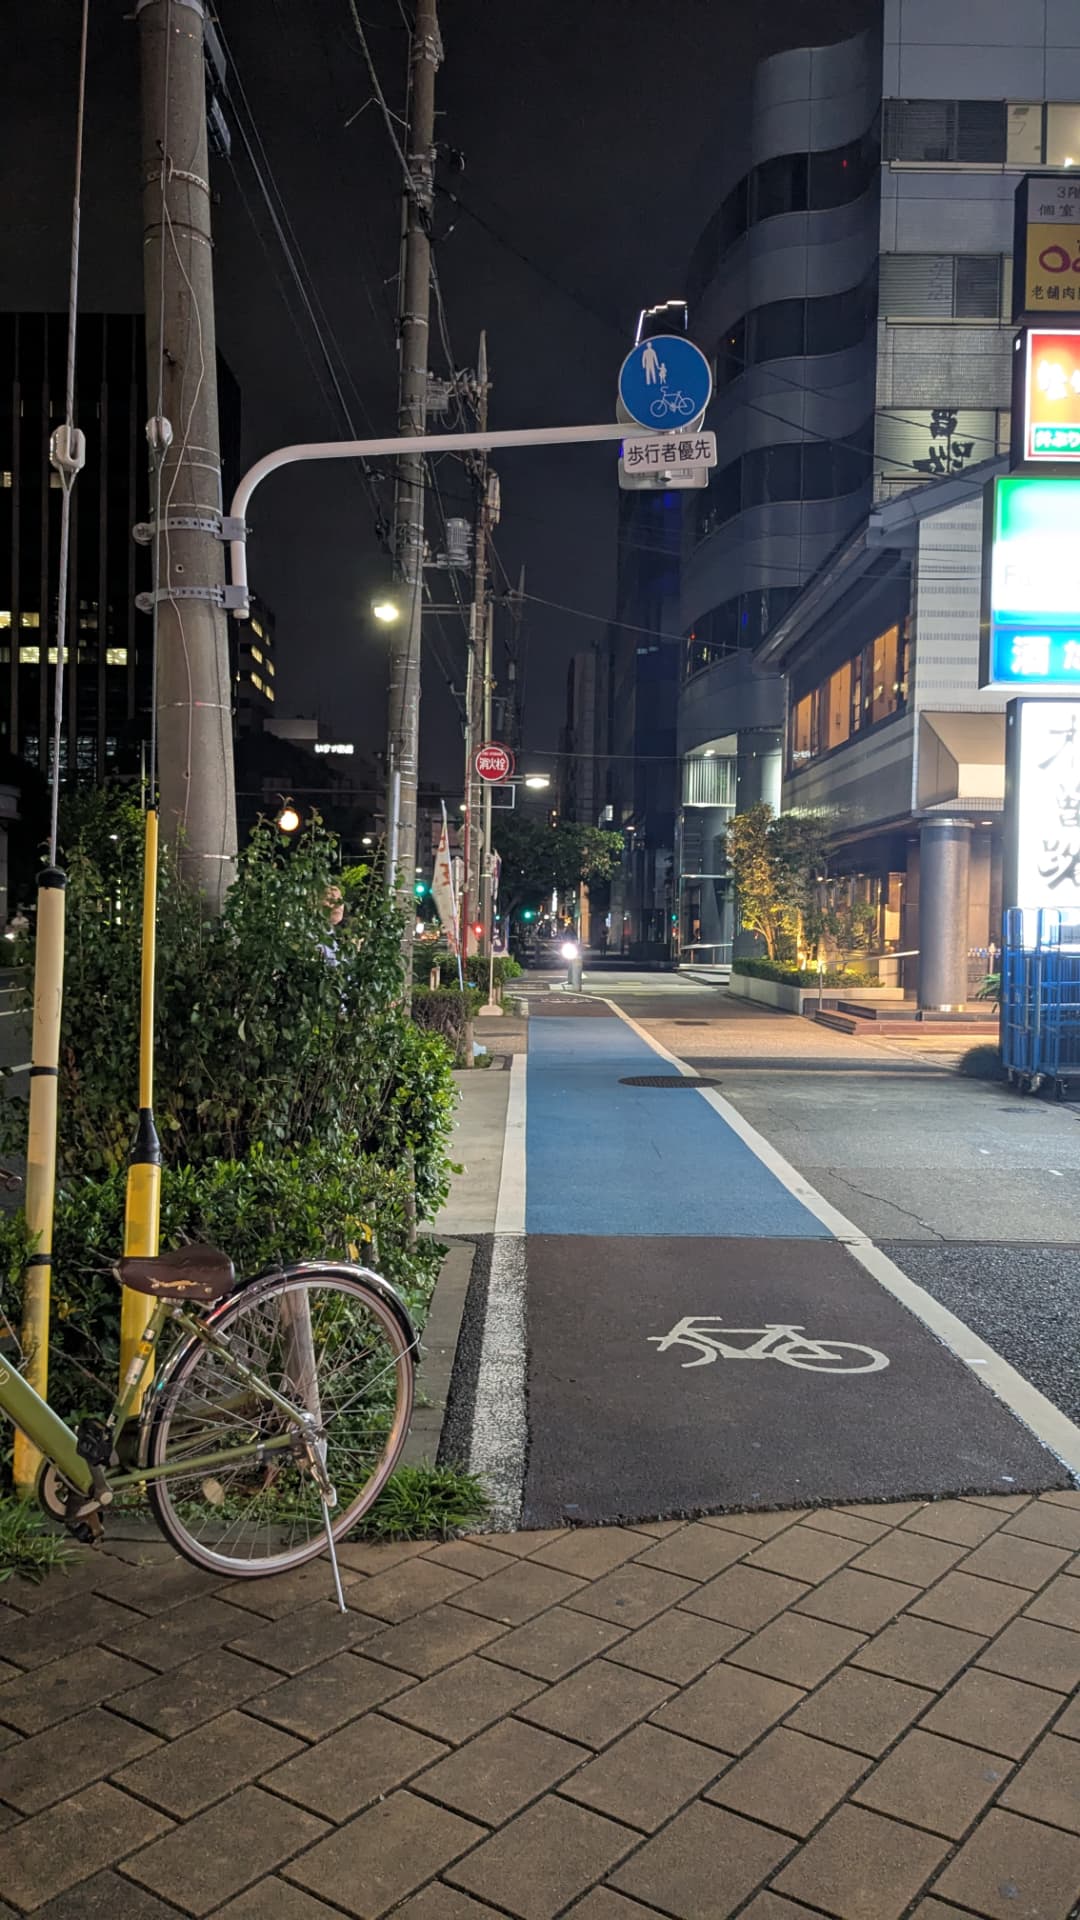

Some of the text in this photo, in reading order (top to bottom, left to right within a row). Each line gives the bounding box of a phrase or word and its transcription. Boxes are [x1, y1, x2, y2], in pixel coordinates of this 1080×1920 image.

[1039, 203, 1080, 217] 個室
[1032, 285, 1080, 301] 老舗肉
[627, 440, 711, 466] 歩行者優先
[479, 757, 506, 770] 消火栓
